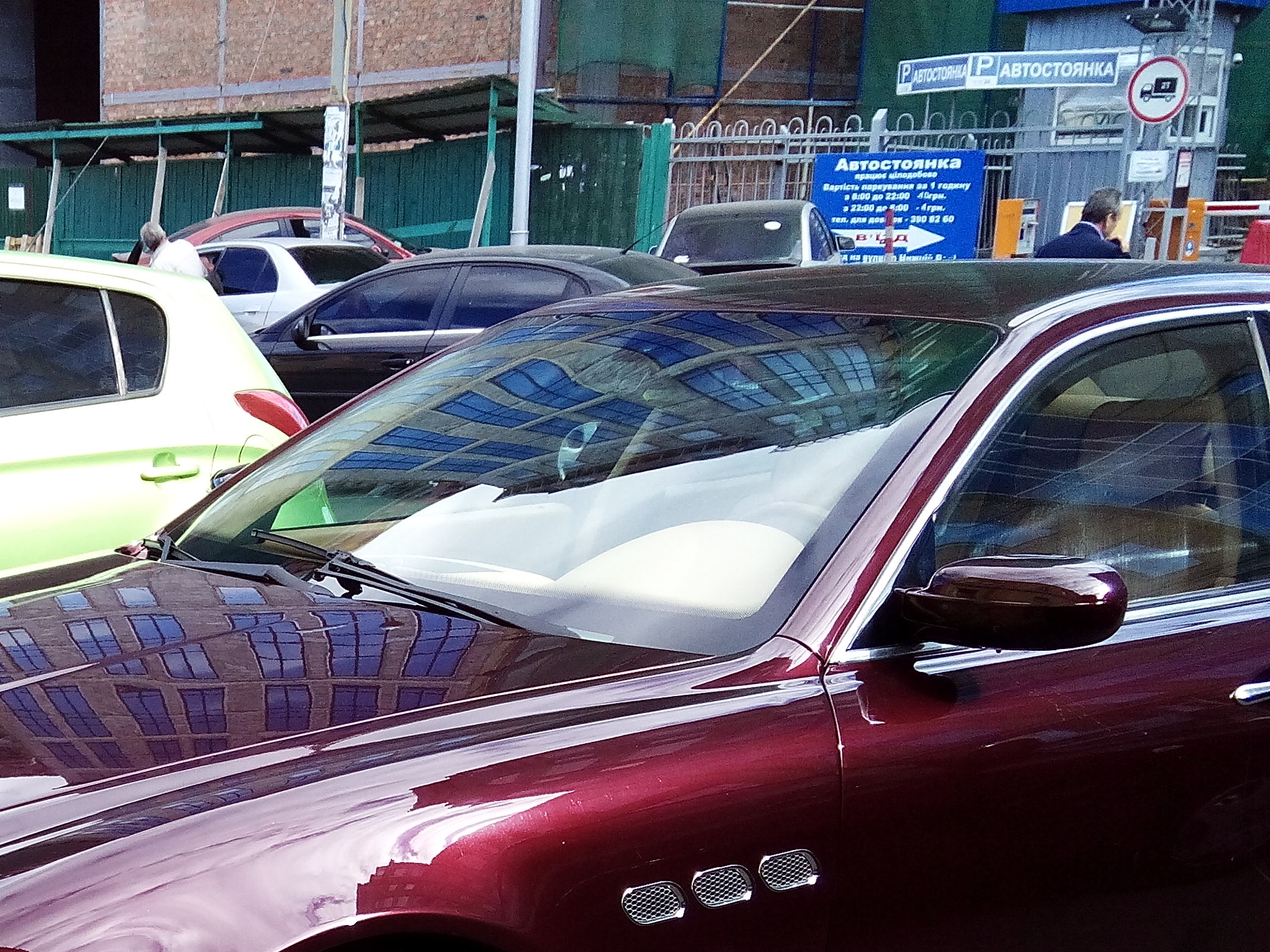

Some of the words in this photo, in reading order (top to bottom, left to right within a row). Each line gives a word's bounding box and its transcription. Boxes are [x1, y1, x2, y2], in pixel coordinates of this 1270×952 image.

[913, 63, 968, 84] АВТОСТОЯНКА
[1000, 61, 1115, 79] АВТОСТОЯНКА
[835, 157, 962, 171] Автостоянка
[889, 170, 938, 180] цілодобово
[823, 182, 860, 192] Вартість
[861, 182, 914, 192] паркування
[931, 181, 936, 189] 1
[937, 182, 971, 191] годину
[872, 193, 884, 202] до
[886, 192, 910, 201] 22:00
[850, 203, 875, 212] 22:00
[876, 205, 888, 213] до
[850, 216, 867, 224] для
[868, 216, 903, 224] довок
[942, 215, 955, 223] 60
